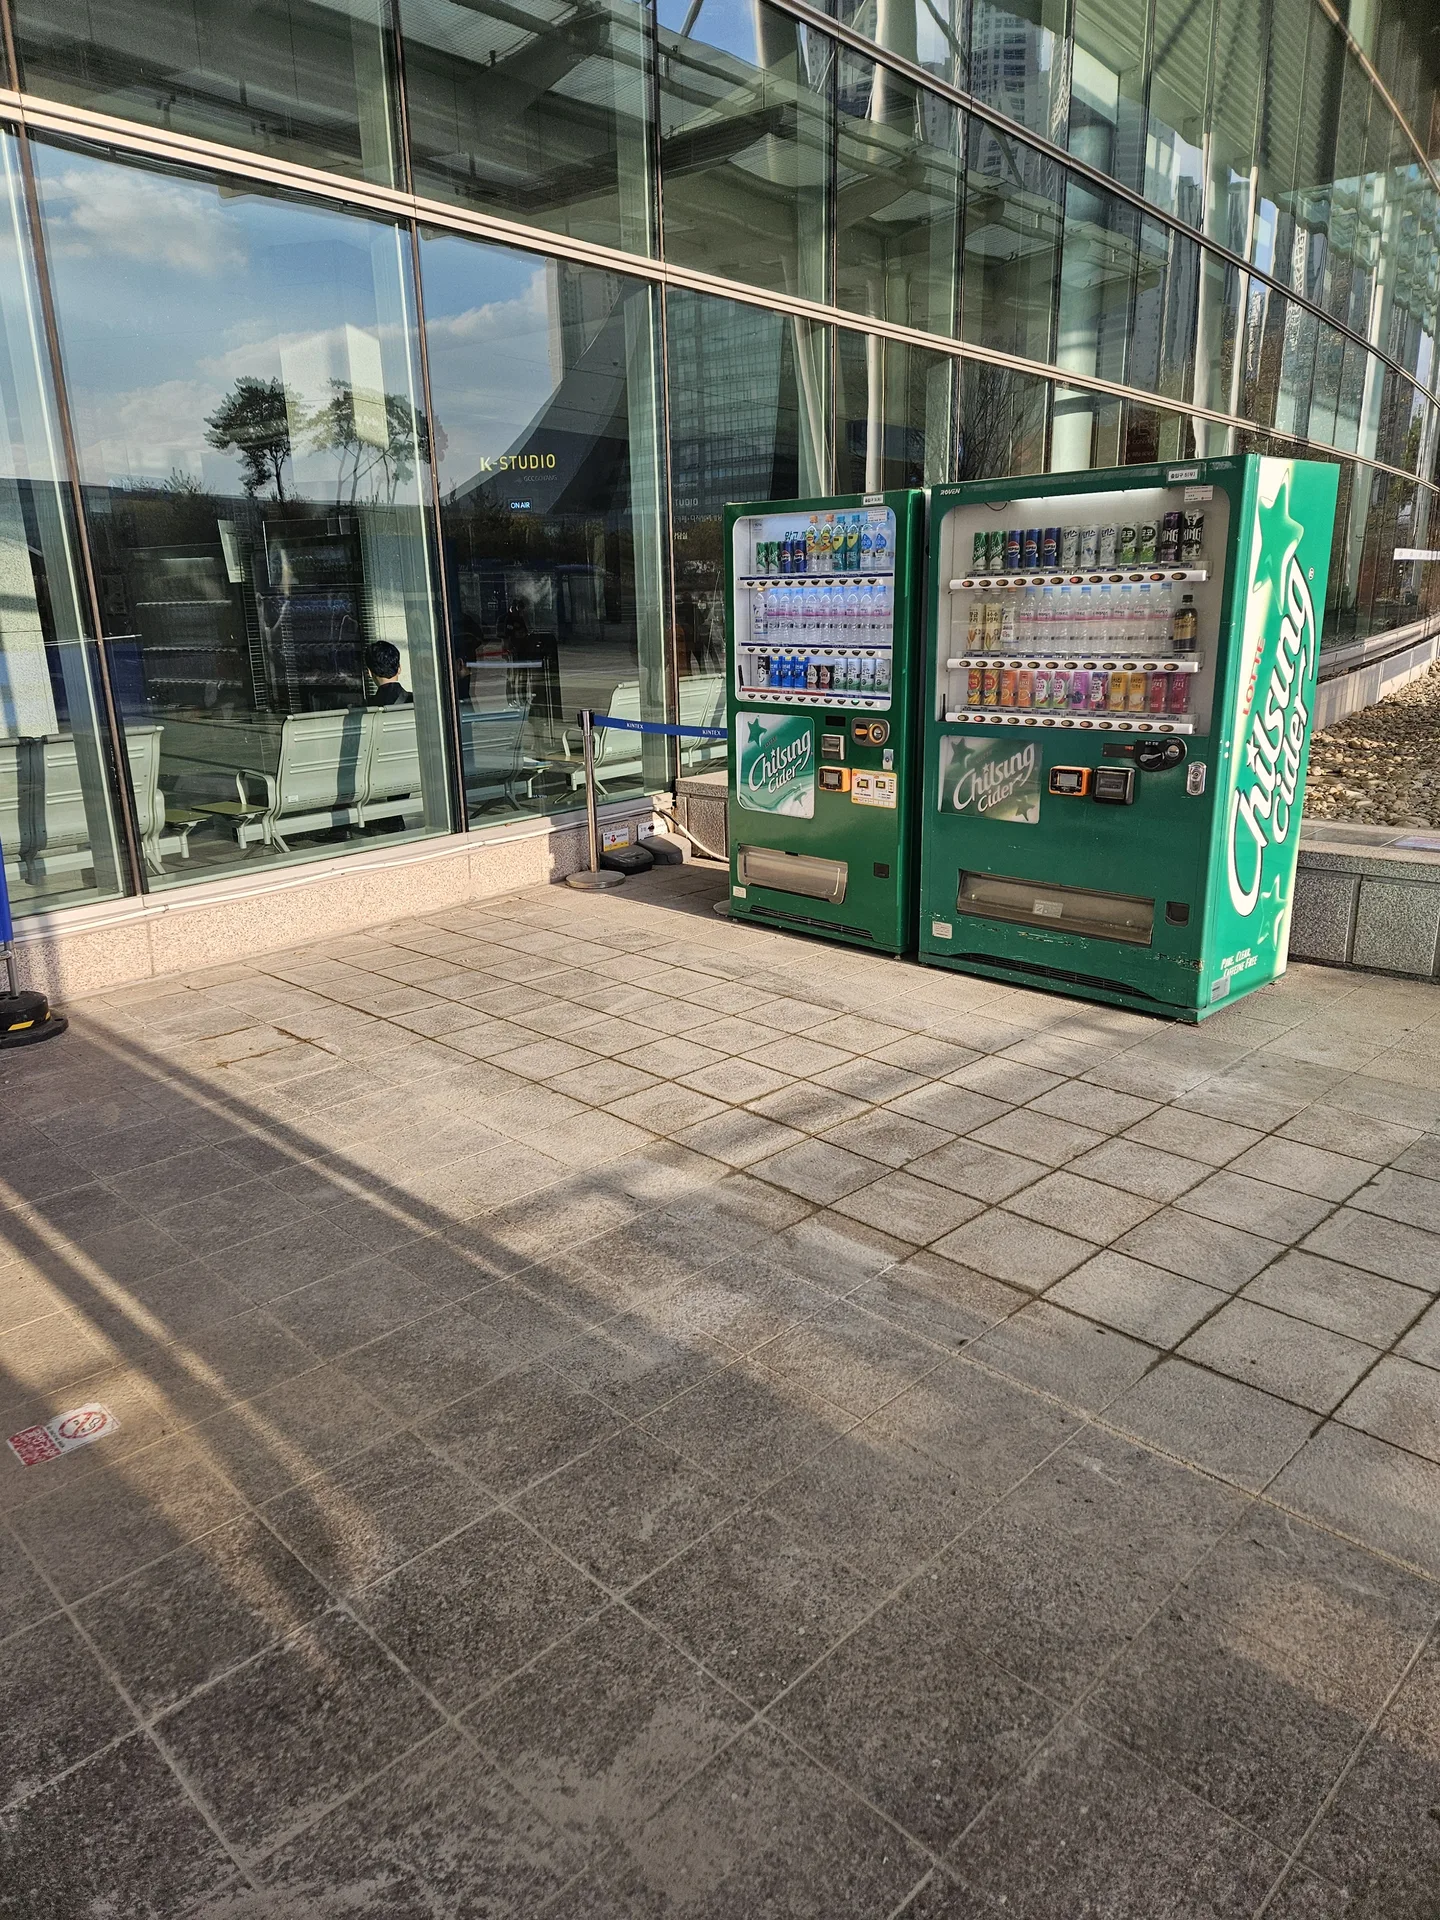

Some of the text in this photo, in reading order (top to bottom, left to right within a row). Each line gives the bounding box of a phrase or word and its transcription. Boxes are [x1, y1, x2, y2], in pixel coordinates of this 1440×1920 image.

[480, 453, 556, 472] K-STUDIO
[521, 501, 531, 509] AIR
[1242, 635, 1267, 717] LOTTE
[626, 722, 644, 730] KINTEX
[1228, 554, 1315, 917] Chilsung
[748, 730, 811, 792] Chilsung
[952, 742, 1035, 811] Chilsung
